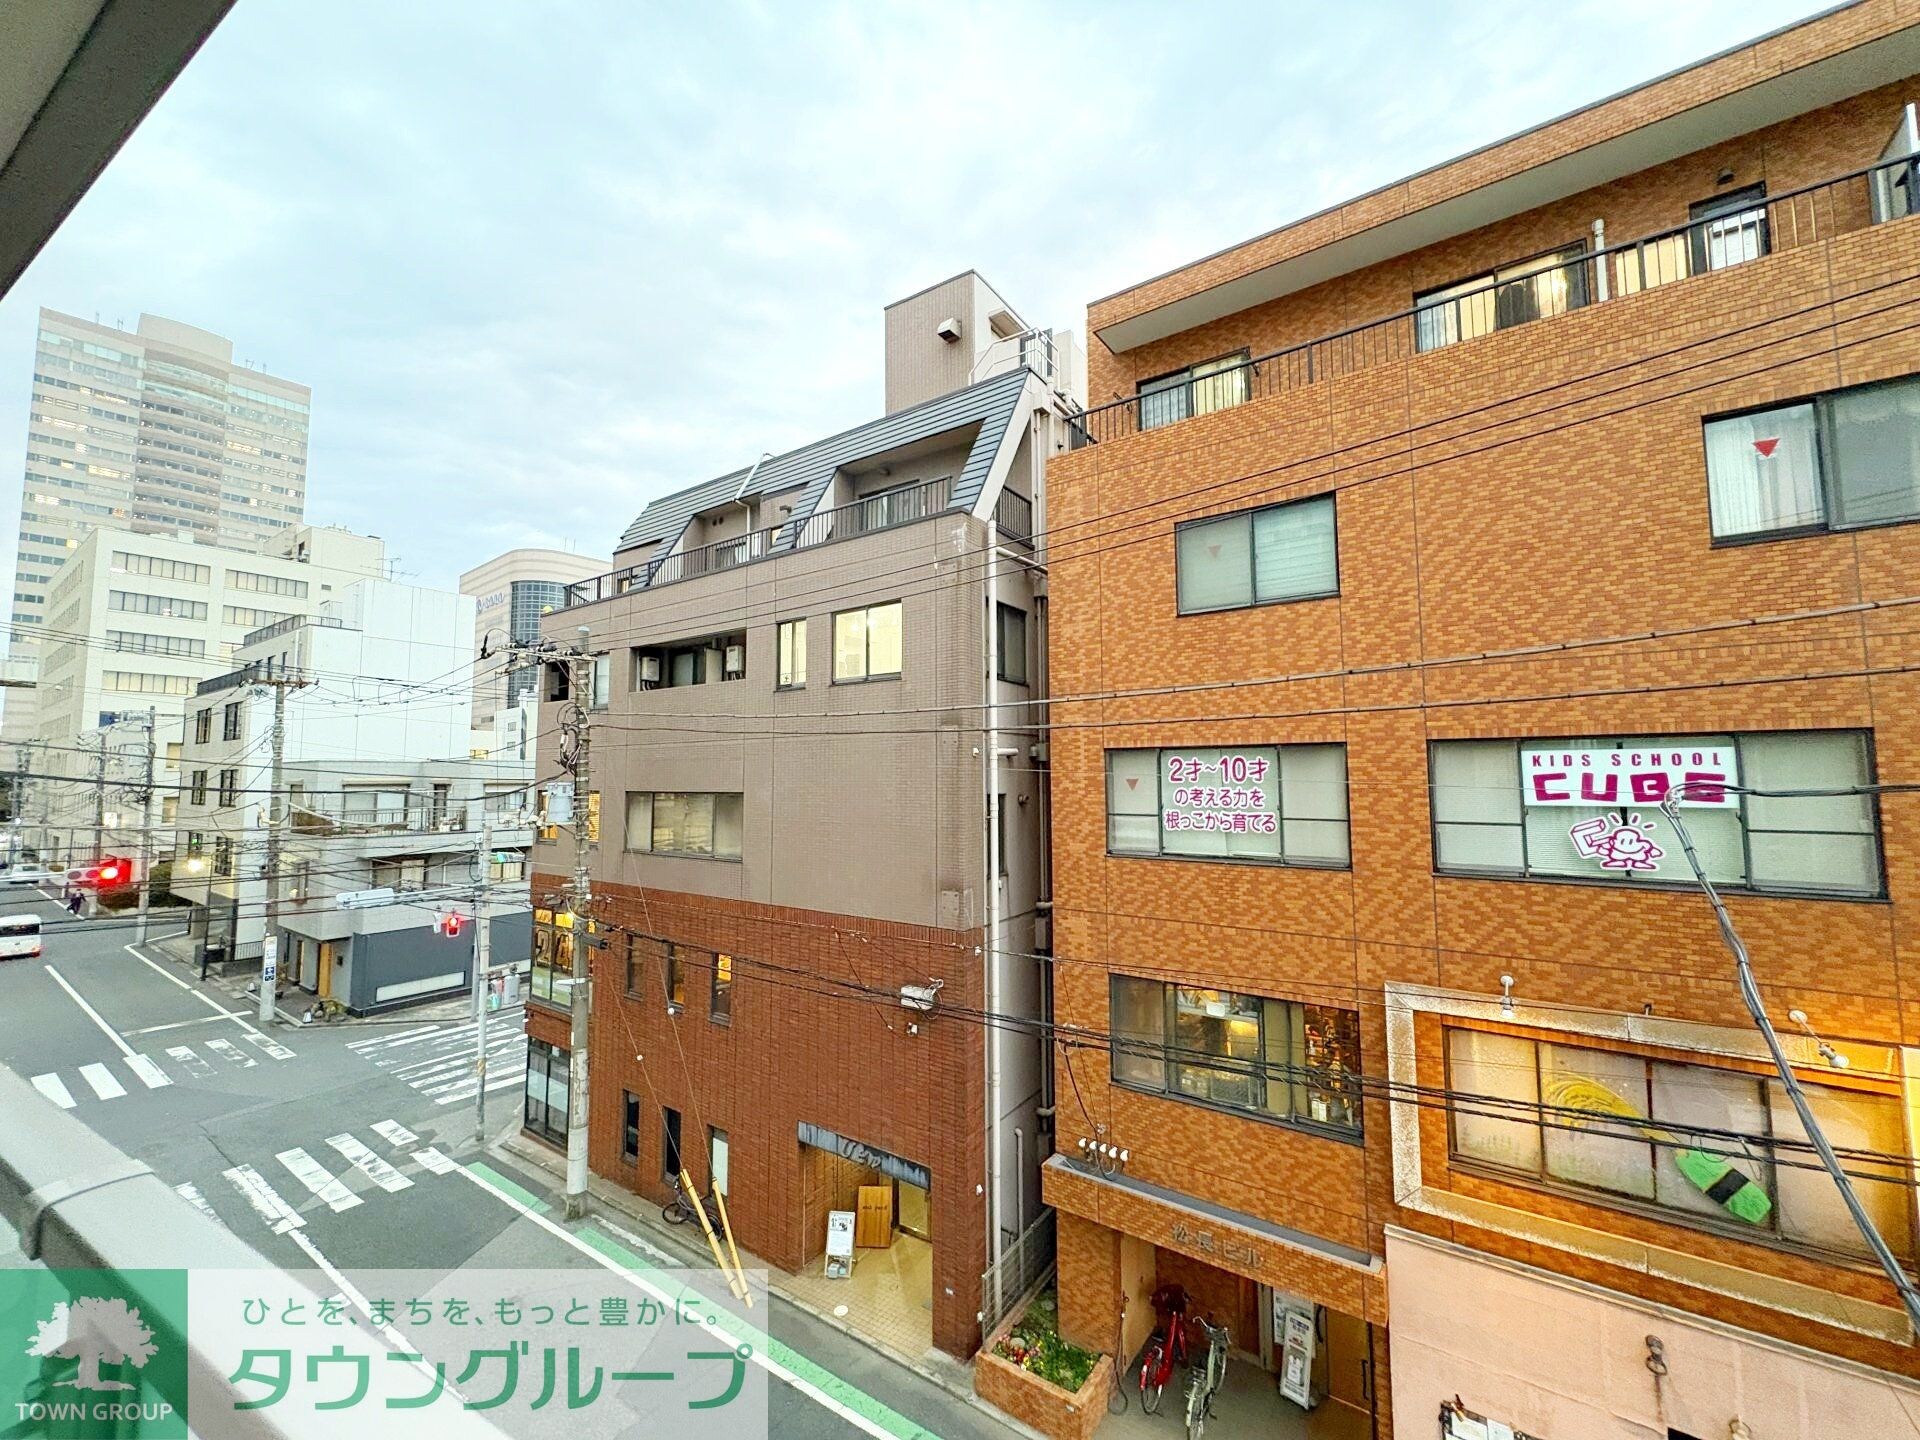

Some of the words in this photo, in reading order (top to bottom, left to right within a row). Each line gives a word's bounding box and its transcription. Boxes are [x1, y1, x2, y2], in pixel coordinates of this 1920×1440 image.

[1532, 754, 1591, 767] KIDS
[1611, 752, 1722, 767] SCHOOL
[1174, 788, 1265, 808] の考える力を
[1532, 772, 1726, 803] CUBE
[1165, 811, 1277, 834] 根っこから育てる
